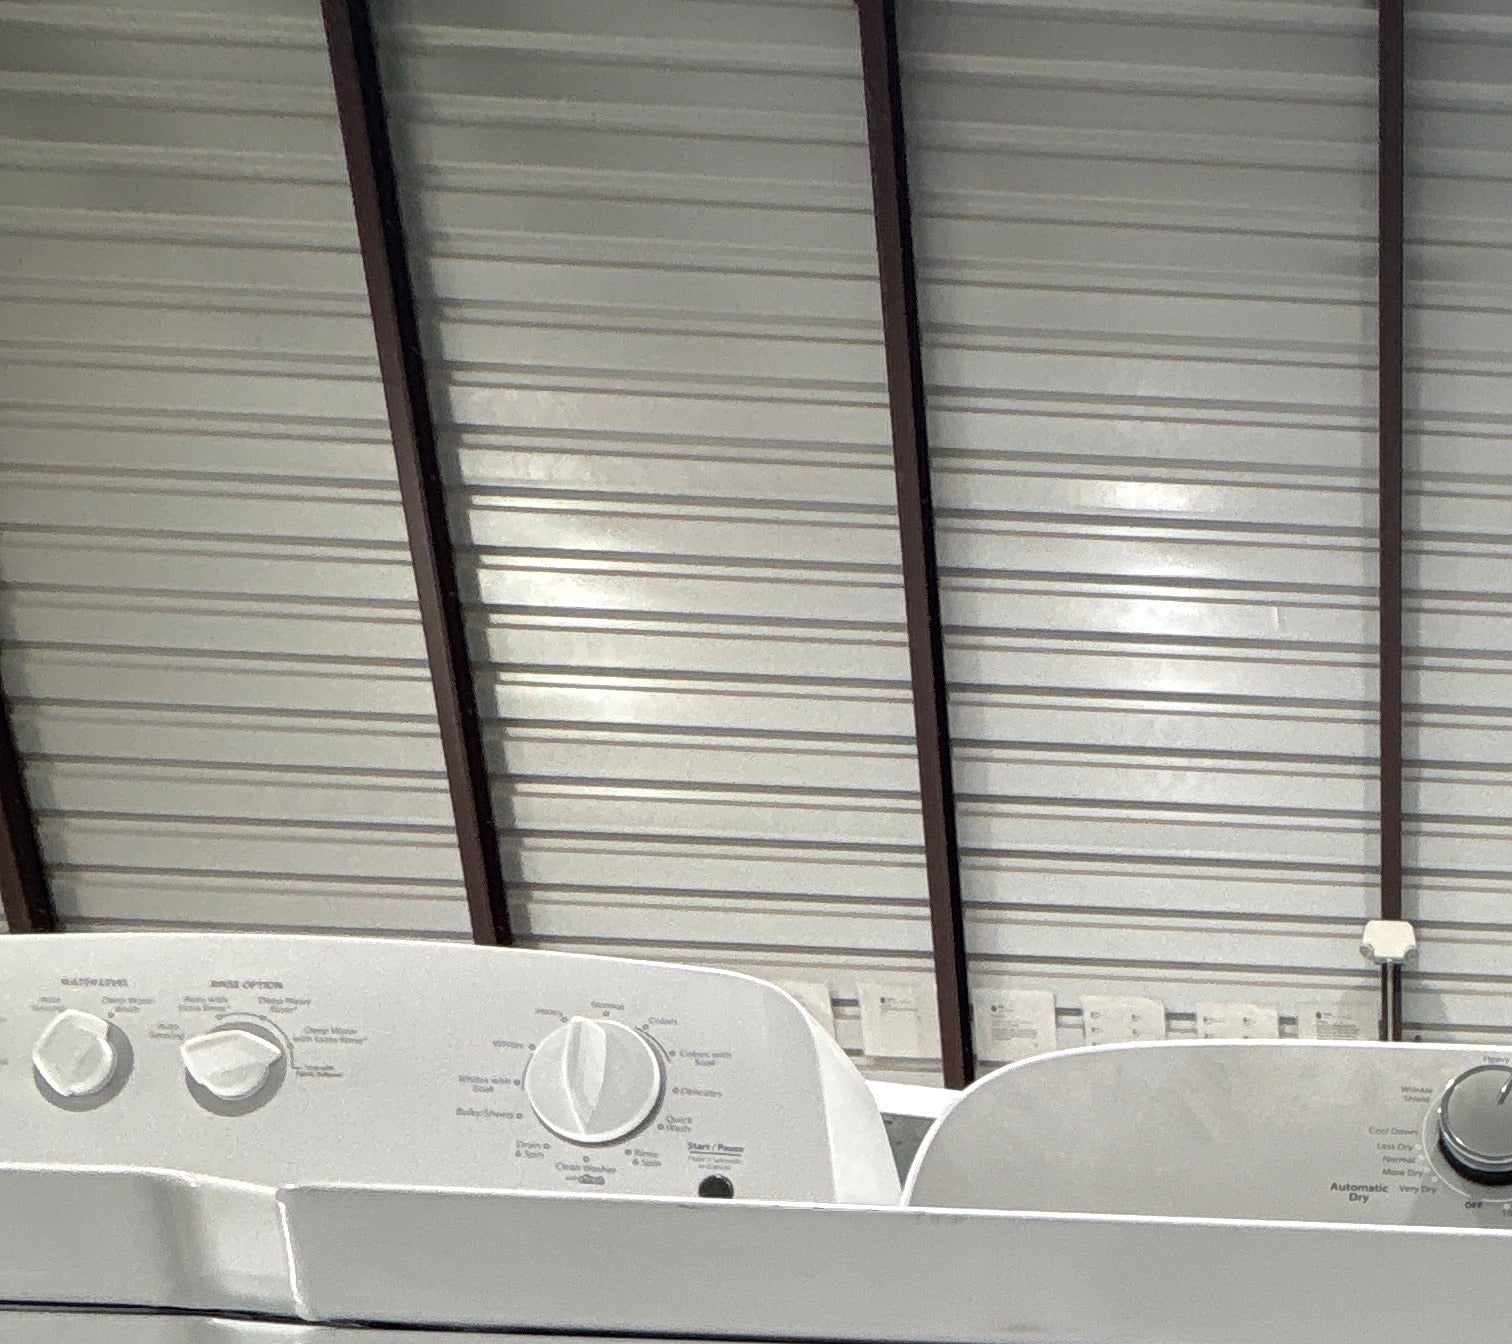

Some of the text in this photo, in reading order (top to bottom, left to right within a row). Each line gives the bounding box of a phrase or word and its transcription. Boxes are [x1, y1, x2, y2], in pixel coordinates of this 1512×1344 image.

[1377, 1142, 1413, 1152] Less Dry
[1382, 1168, 1422, 1178] More Dry
[1330, 1183, 1389, 1193] Automatic
[1399, 1185, 1437, 1196] Very Dry
[1349, 1193, 1369, 1204] Dry
